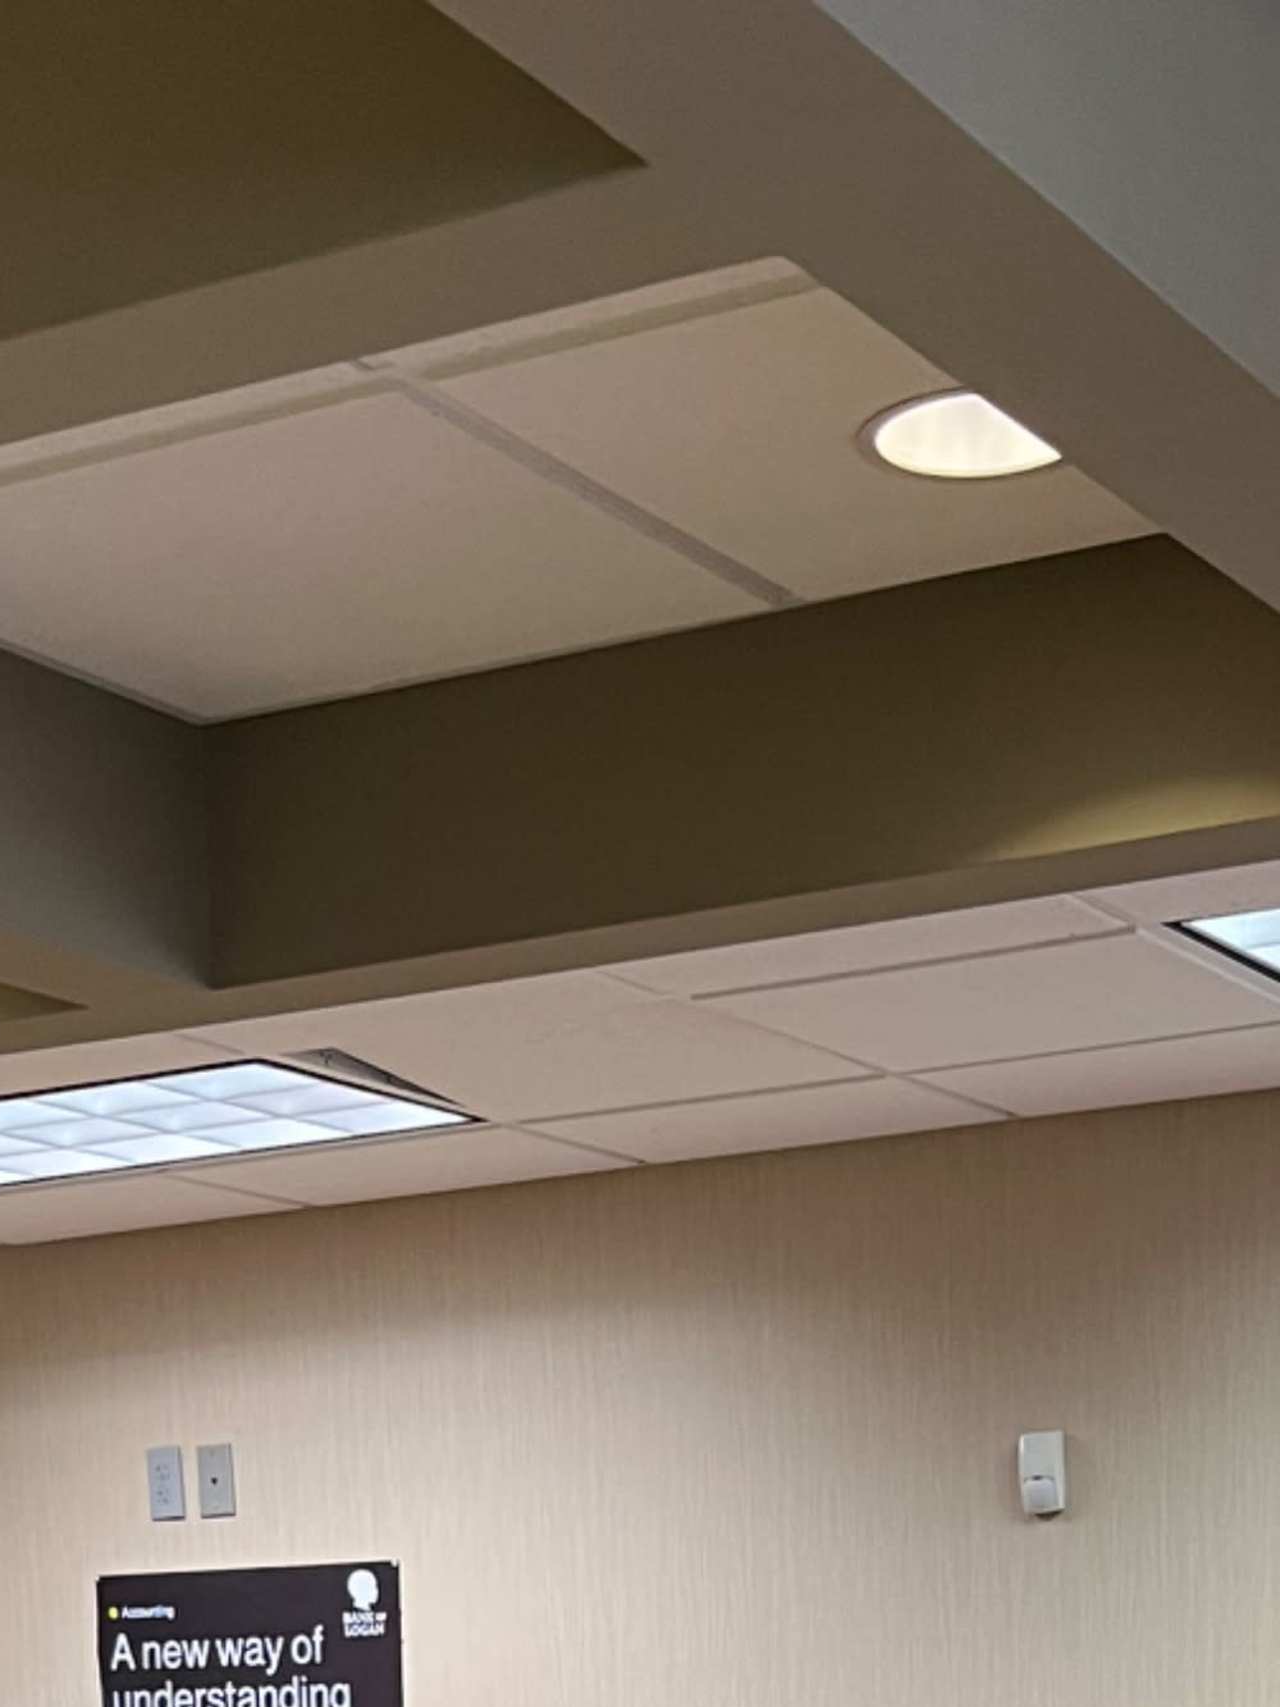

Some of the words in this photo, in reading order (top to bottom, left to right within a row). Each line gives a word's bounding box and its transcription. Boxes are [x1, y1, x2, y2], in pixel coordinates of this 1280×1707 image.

[110, 1632, 137, 1672] A
[141, 1638, 210, 1671] new
[215, 1635, 284, 1676] way
[290, 1624, 324, 1665] of
